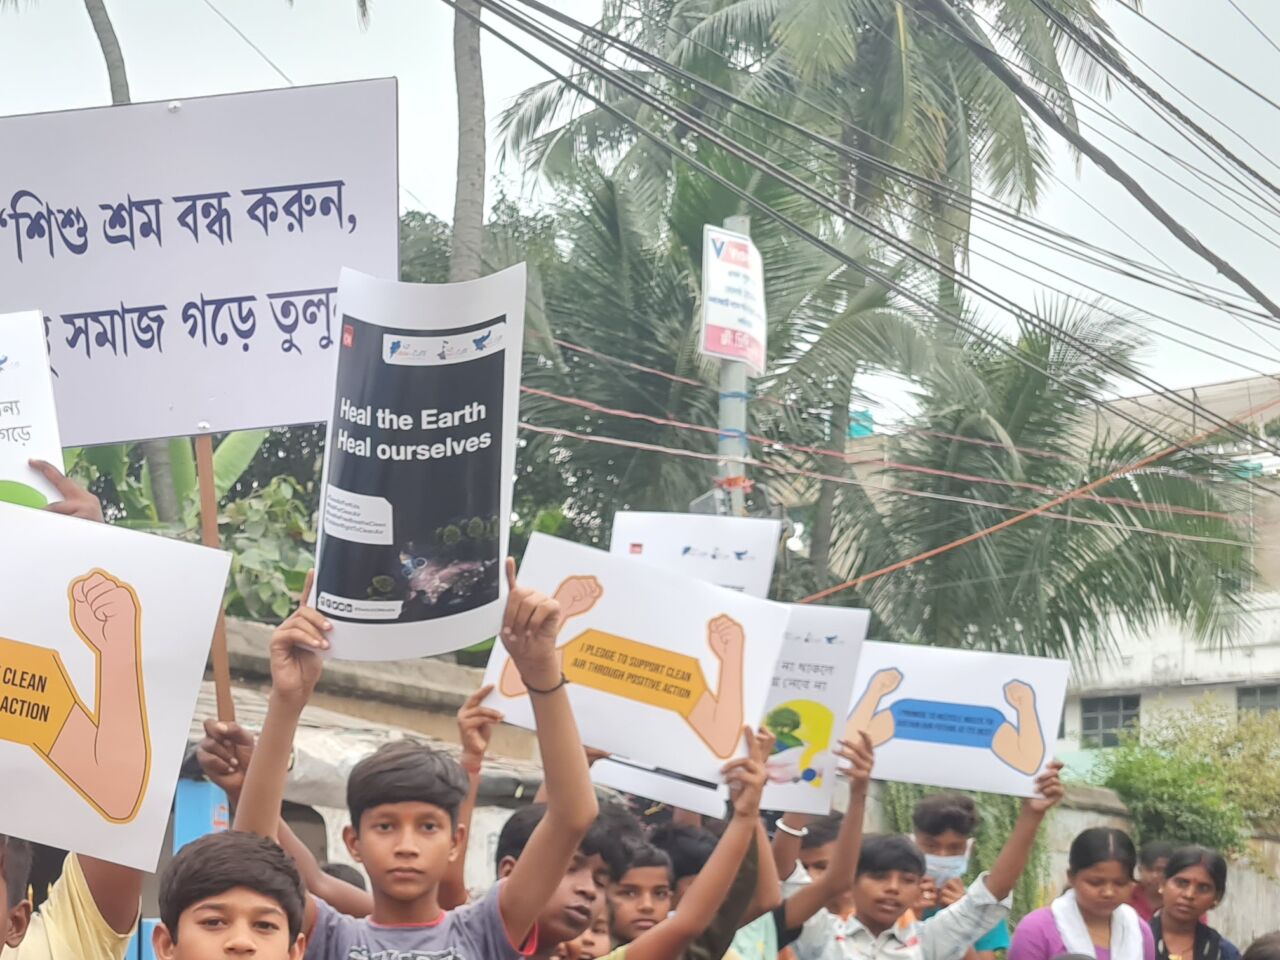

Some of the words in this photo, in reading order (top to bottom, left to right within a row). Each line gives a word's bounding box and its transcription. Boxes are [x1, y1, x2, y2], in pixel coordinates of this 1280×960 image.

[99, 193, 163, 251] শ্রম
[172, 191, 233, 246] বন্ধ
[241, 180, 357, 236] করুন,
[60, 300, 167, 359] সমাজ
[181, 292, 257, 353] গড়ে
[340, 397, 371, 426] Heal
[376, 408, 414, 430] the
[421, 402, 486, 430] Earth
[337, 428, 370, 457] Heal
[376, 432, 492, 460] ourselves
[2, 667, 48, 693] CLEAN
[573, 658, 587, 669] AIR
[587, 662, 626, 680] THROUGH
[626, 673, 662, 691] POSITIVE
[662, 683, 691, 699] ACTION
[585, 644, 617, 661] PLEDGE
[617, 653, 628, 664] TO
[629, 657, 665, 673] SUPPORT
[666, 667, 692, 682] CLEAN
[0, 695, 50, 722] ACTION
